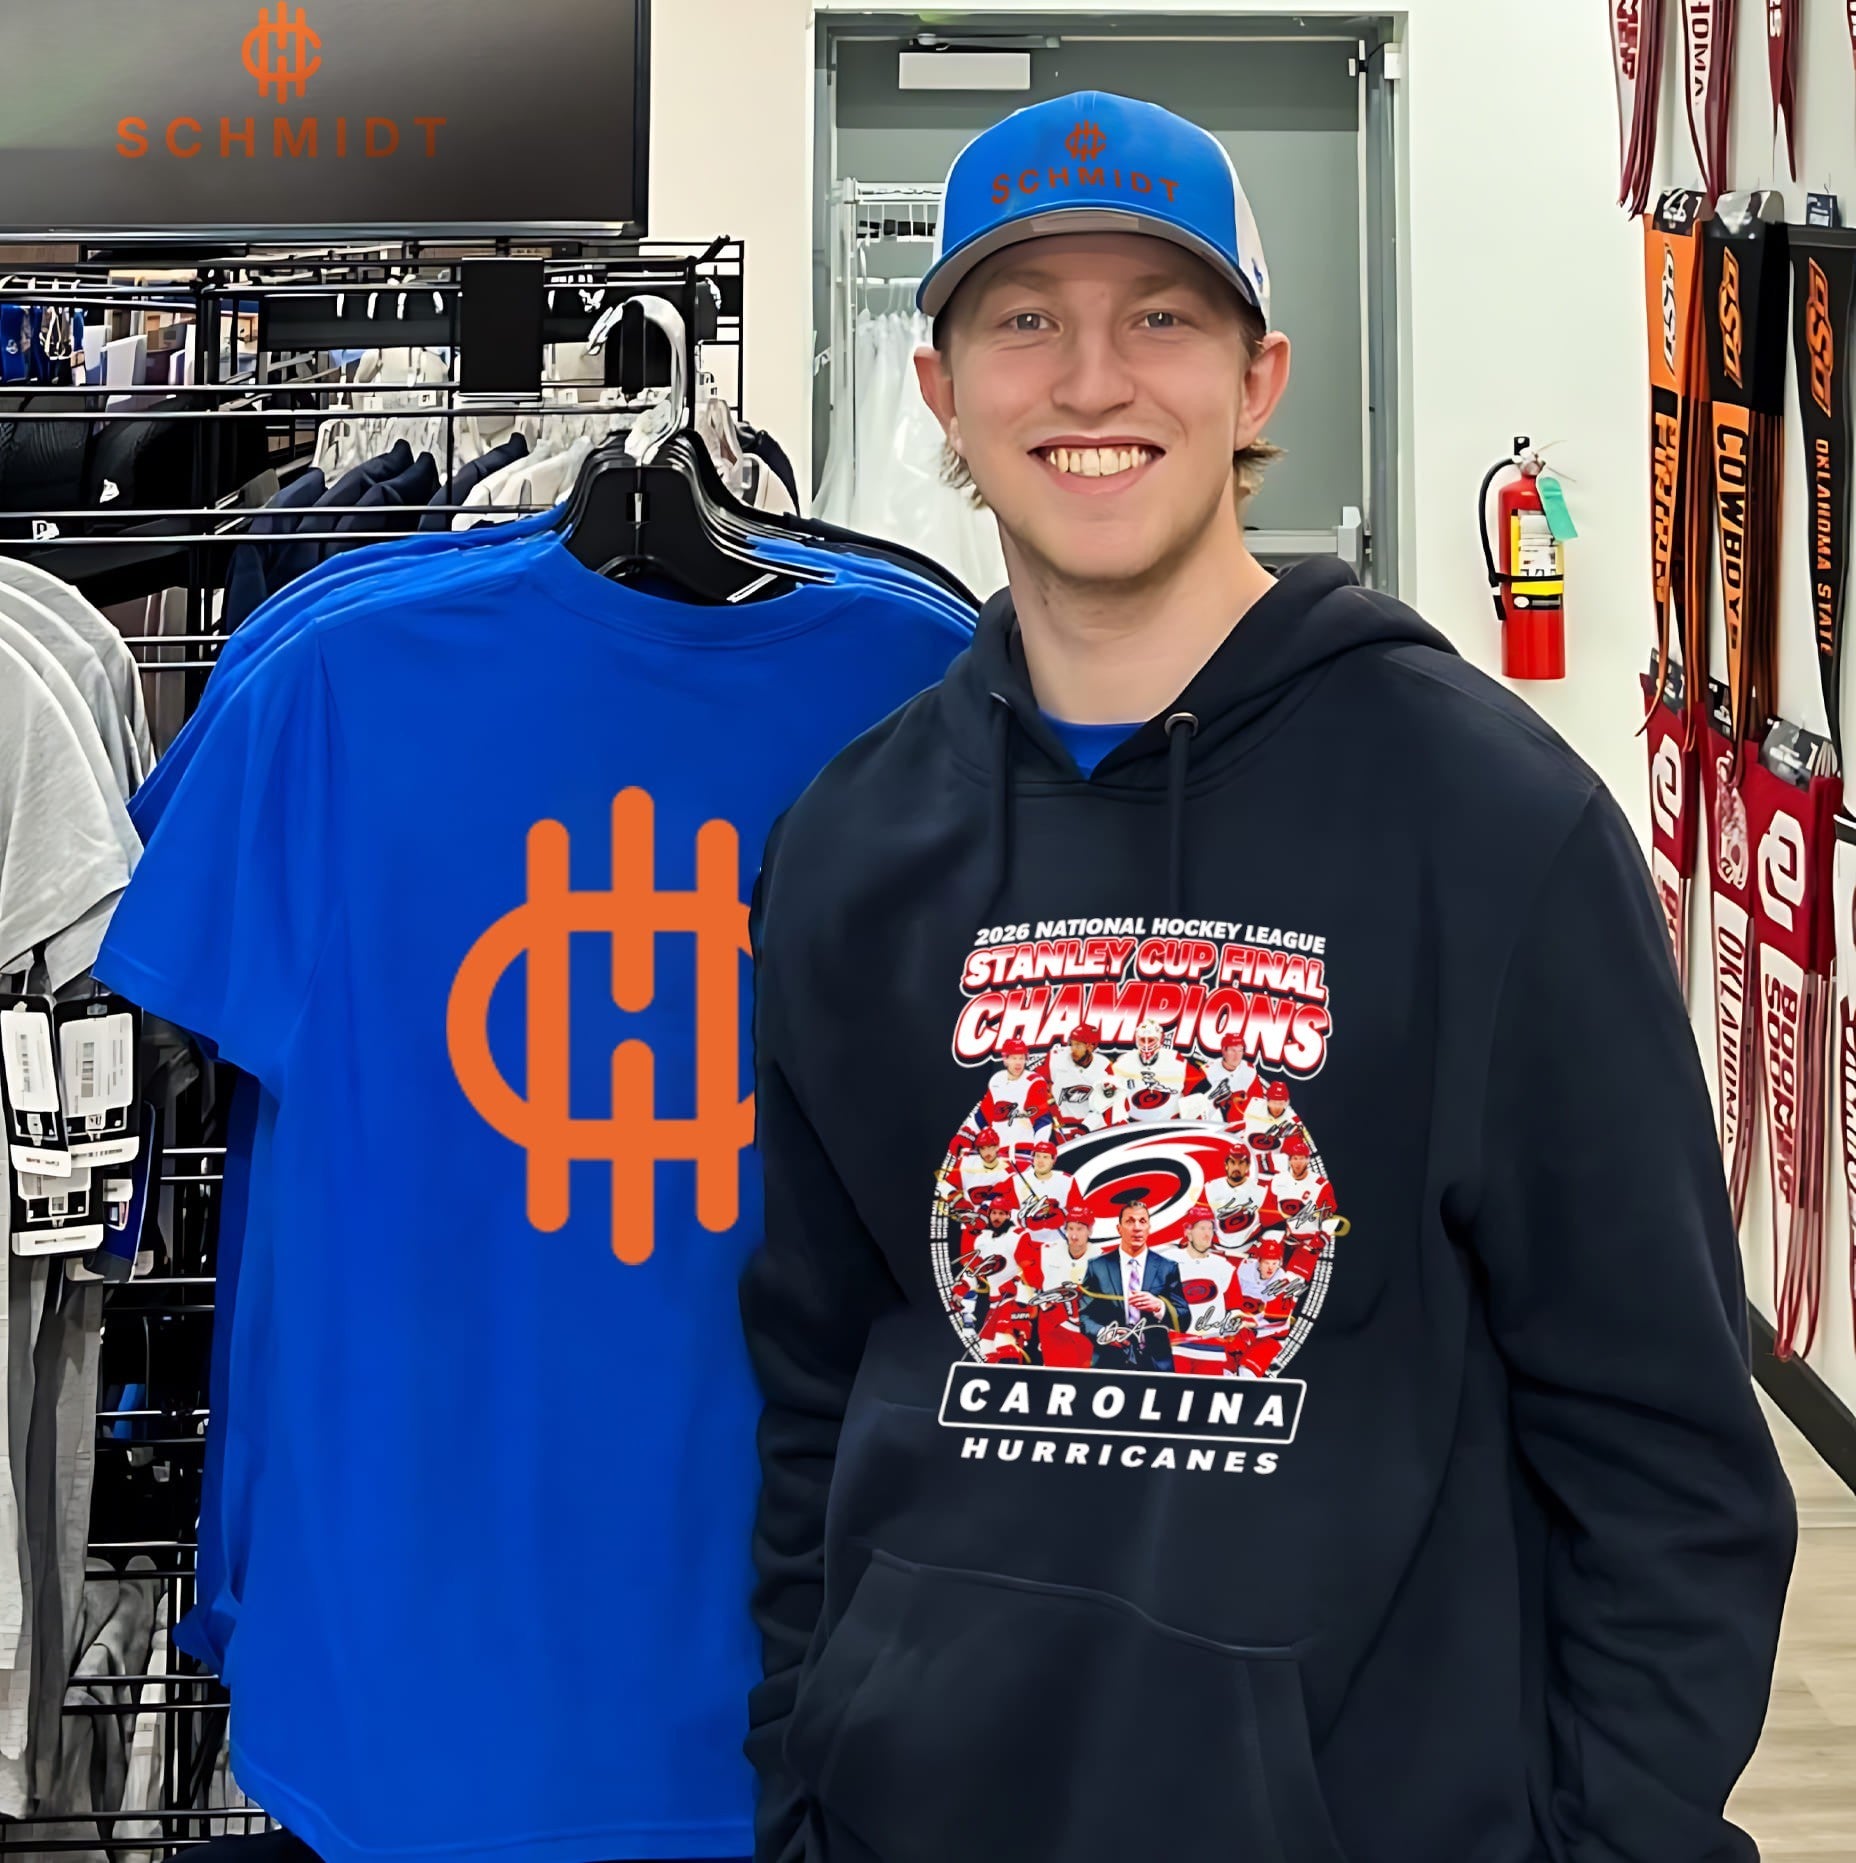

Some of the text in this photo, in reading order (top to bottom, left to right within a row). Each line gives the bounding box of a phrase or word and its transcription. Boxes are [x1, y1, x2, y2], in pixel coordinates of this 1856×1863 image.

[116, 116, 448, 159] SCHMIDT
[991, 166, 1179, 205] SCHMIDT
[974, 917, 1327, 955] 2026 NATIONAL HOCKEY LEAGUE
[961, 937, 1328, 1001] STANLEY CUP FINAL
[953, 981, 1331, 1075] CHAMPIONS
[959, 1378, 1285, 1428] CAROLINA
[961, 1437, 1279, 1475] HURRICANES
